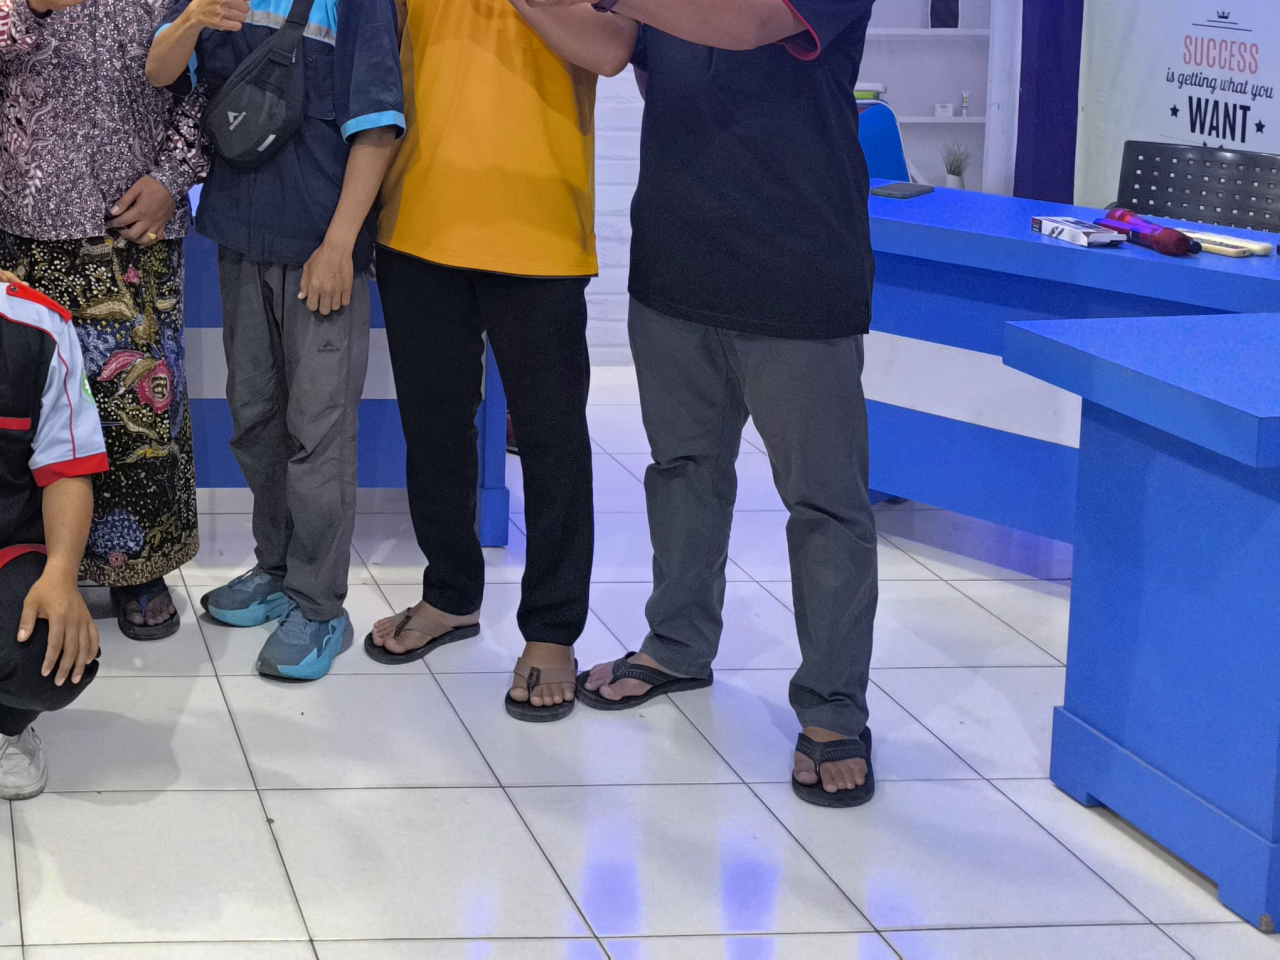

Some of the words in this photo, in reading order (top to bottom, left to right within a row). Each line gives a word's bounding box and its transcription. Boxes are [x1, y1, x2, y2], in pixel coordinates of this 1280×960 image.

[1183, 35, 1259, 74] SUCCESS
[1166, 67, 1175, 83] is
[1177, 71, 1218, 95] getting
[1220, 75, 1249, 95] what
[1250, 82, 1274, 102] you
[1188, 95, 1251, 143] WANT
